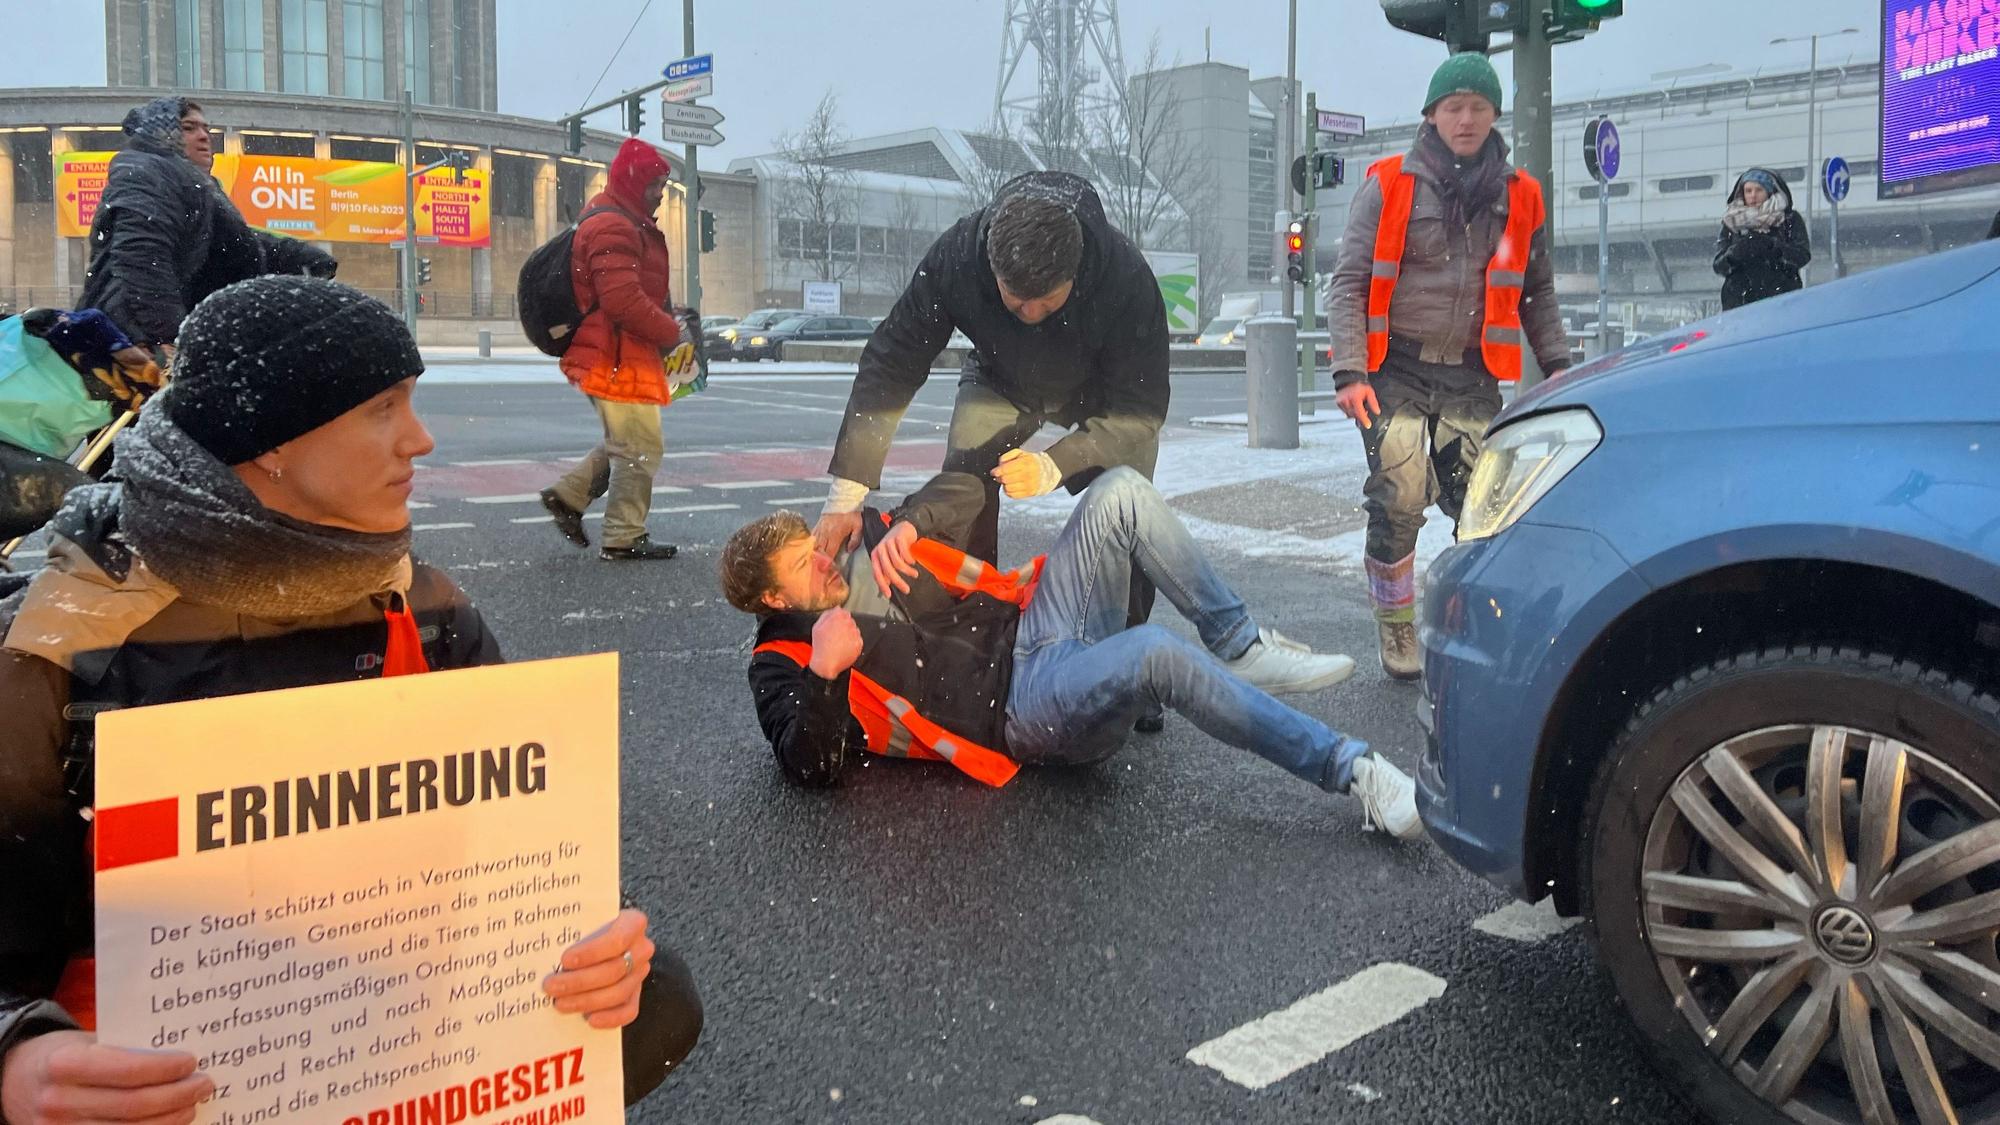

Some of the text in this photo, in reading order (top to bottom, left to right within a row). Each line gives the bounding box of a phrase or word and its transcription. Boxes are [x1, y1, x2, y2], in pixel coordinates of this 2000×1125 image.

[676, 109, 706, 120] Zentrum
[1322, 114, 1359, 129] Messedamm
[671, 128, 712, 141] Busbahnhof
[70, 163, 108, 173] ENTRAN
[253, 165, 304, 184] All in
[81, 179, 107, 189] NORT
[81, 192, 102, 202] HAL
[251, 186, 316, 210] ONE
[330, 189, 359, 199] Berlin
[435, 191, 465, 201] NORTH
[362, 204, 380, 214] Feb
[381, 205, 405, 215] 2023
[435, 205, 468, 215] HALL 27
[435, 215, 465, 225] SOUTH
[435, 225, 458, 235] HALL
[196, 742, 546, 854] ERINNERUNG
[151, 840, 581, 945] Der Staat schützt auch in Verantwortung für
[150, 871, 581, 980] die künftigen Generationen die natürlichen
[151, 901, 581, 1014] Lebensgrundlagen und die Tiere im Rahmen
[151, 926, 582, 1049] der verfassungsmäßigen Ordnung durch die
[197, 1029, 312, 1070] etzgebung
[331, 1008, 368, 1035] und
[385, 993, 431, 1021] nach
[448, 967, 537, 1004] Maßgabe
[246, 991, 557, 1091] und Recht durch die vollziehe
[242, 1095, 280, 1125] und
[288, 1089, 319, 1112] die
[327, 1045, 481, 1102] Rechtsprechung.
